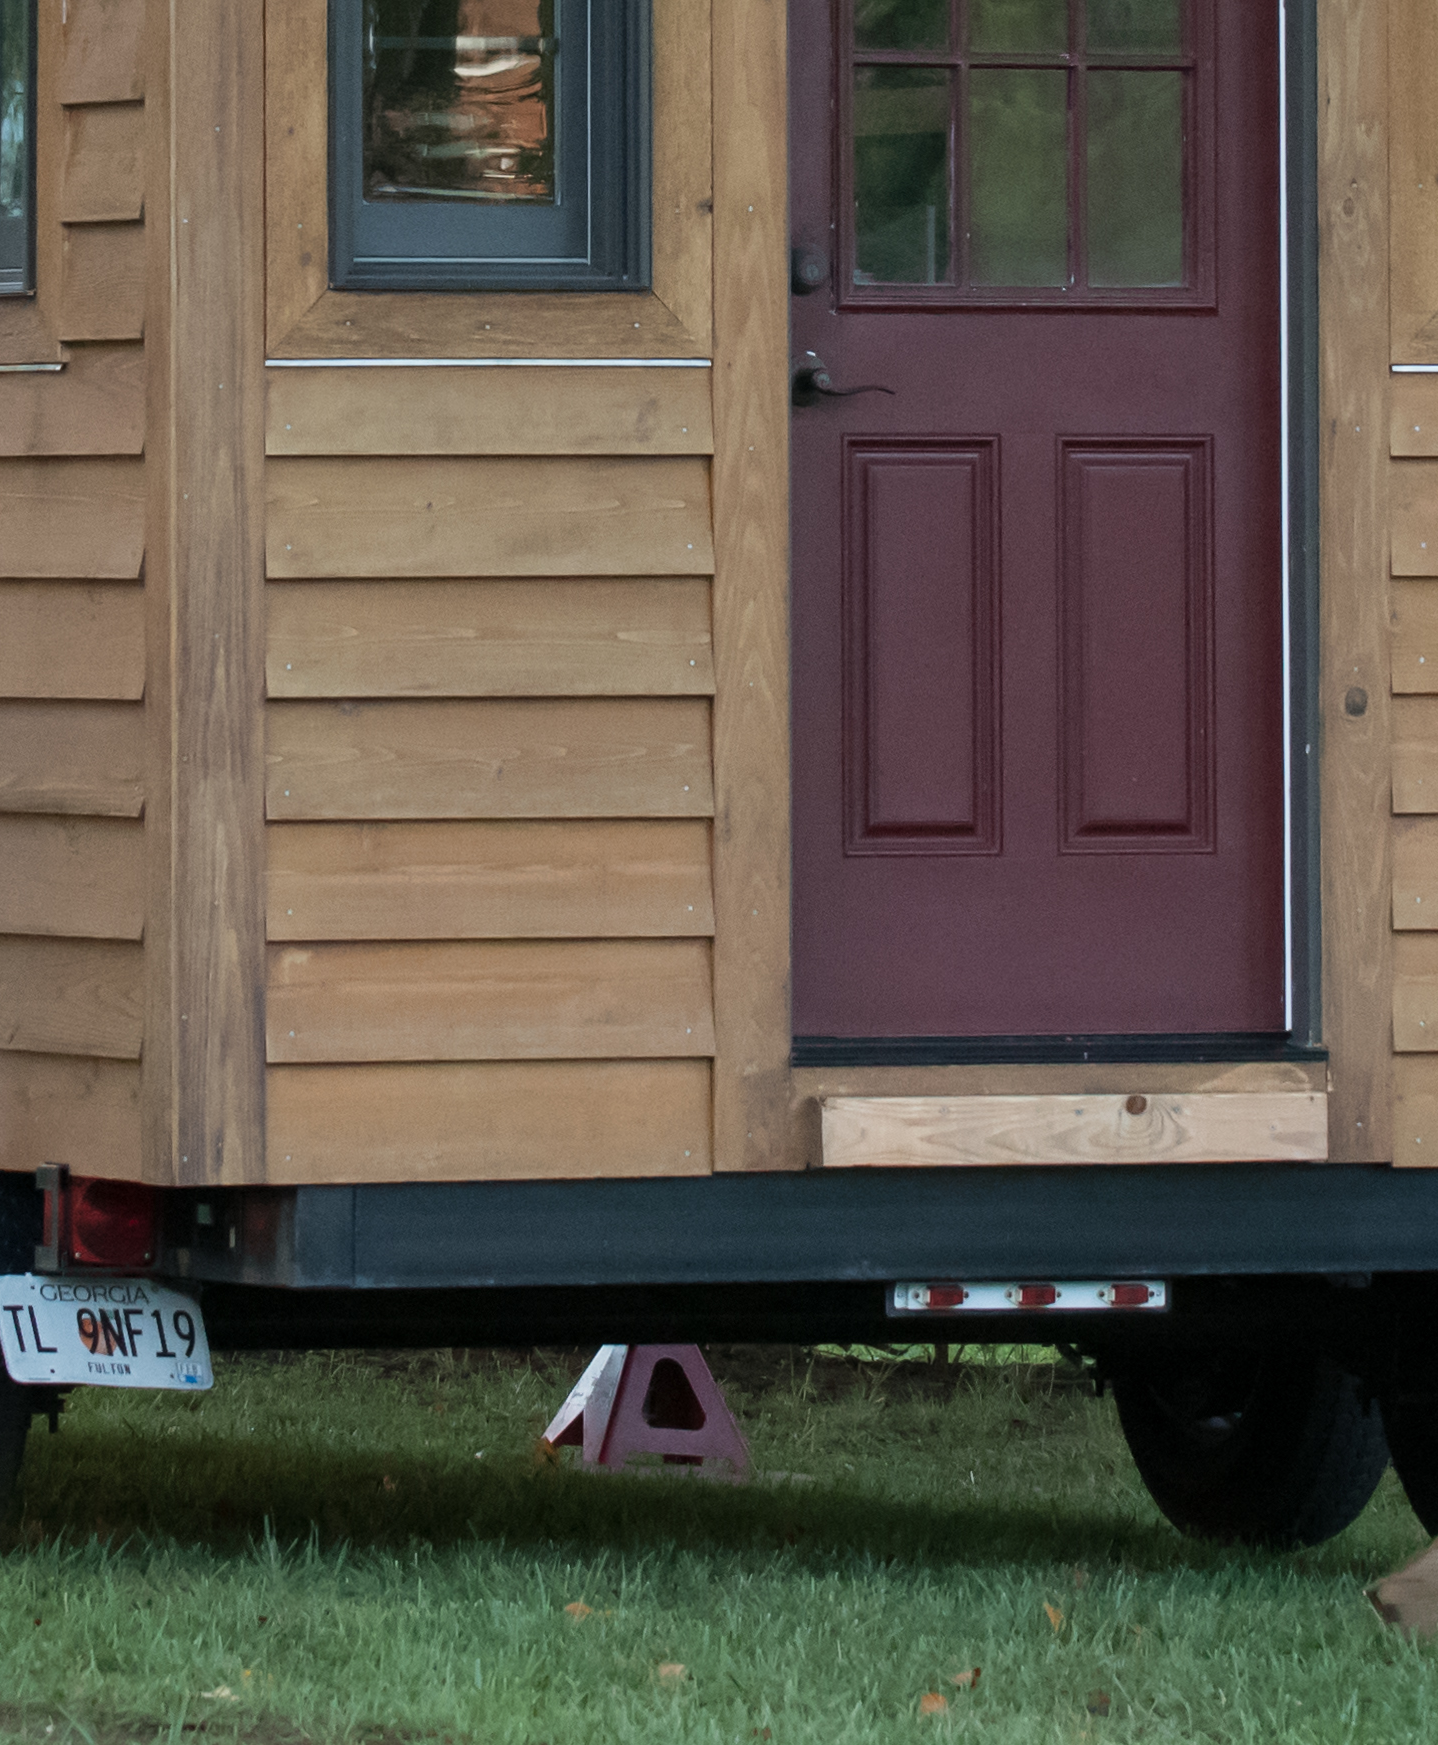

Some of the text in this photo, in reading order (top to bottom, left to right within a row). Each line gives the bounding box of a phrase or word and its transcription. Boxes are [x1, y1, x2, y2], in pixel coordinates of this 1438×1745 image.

[39, 1283, 151, 1305] GEORGIA
[3, 1305, 196, 1358] TL 9NF19
[87, 1361, 132, 1375] FULTON
